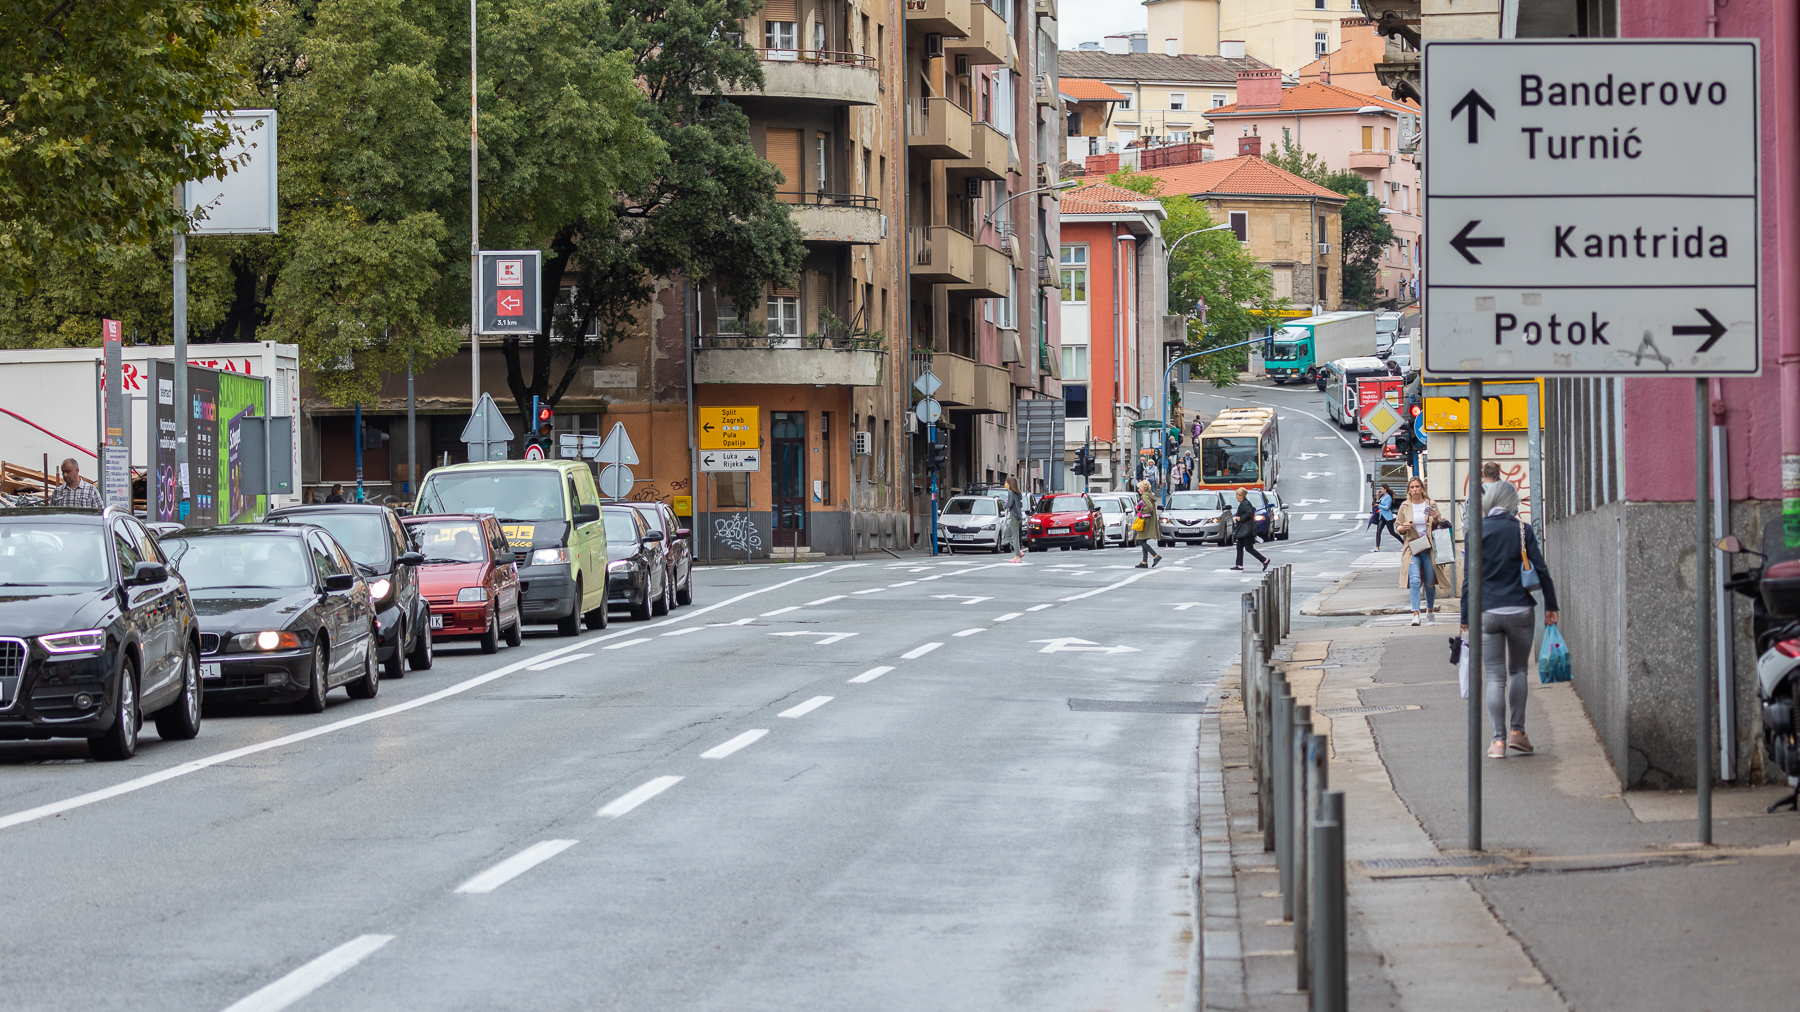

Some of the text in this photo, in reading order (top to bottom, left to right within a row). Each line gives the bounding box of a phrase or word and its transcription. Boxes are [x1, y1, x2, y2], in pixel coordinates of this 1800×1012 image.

[1520, 73, 1728, 106] Banderovo
[1521, 126, 1643, 160] Turnić
[1554, 225, 1728, 258] Kantrida
[1495, 312, 1611, 346] Potok
[721, 409, 737, 417] Split
[722, 417, 745, 425] Zagreb
